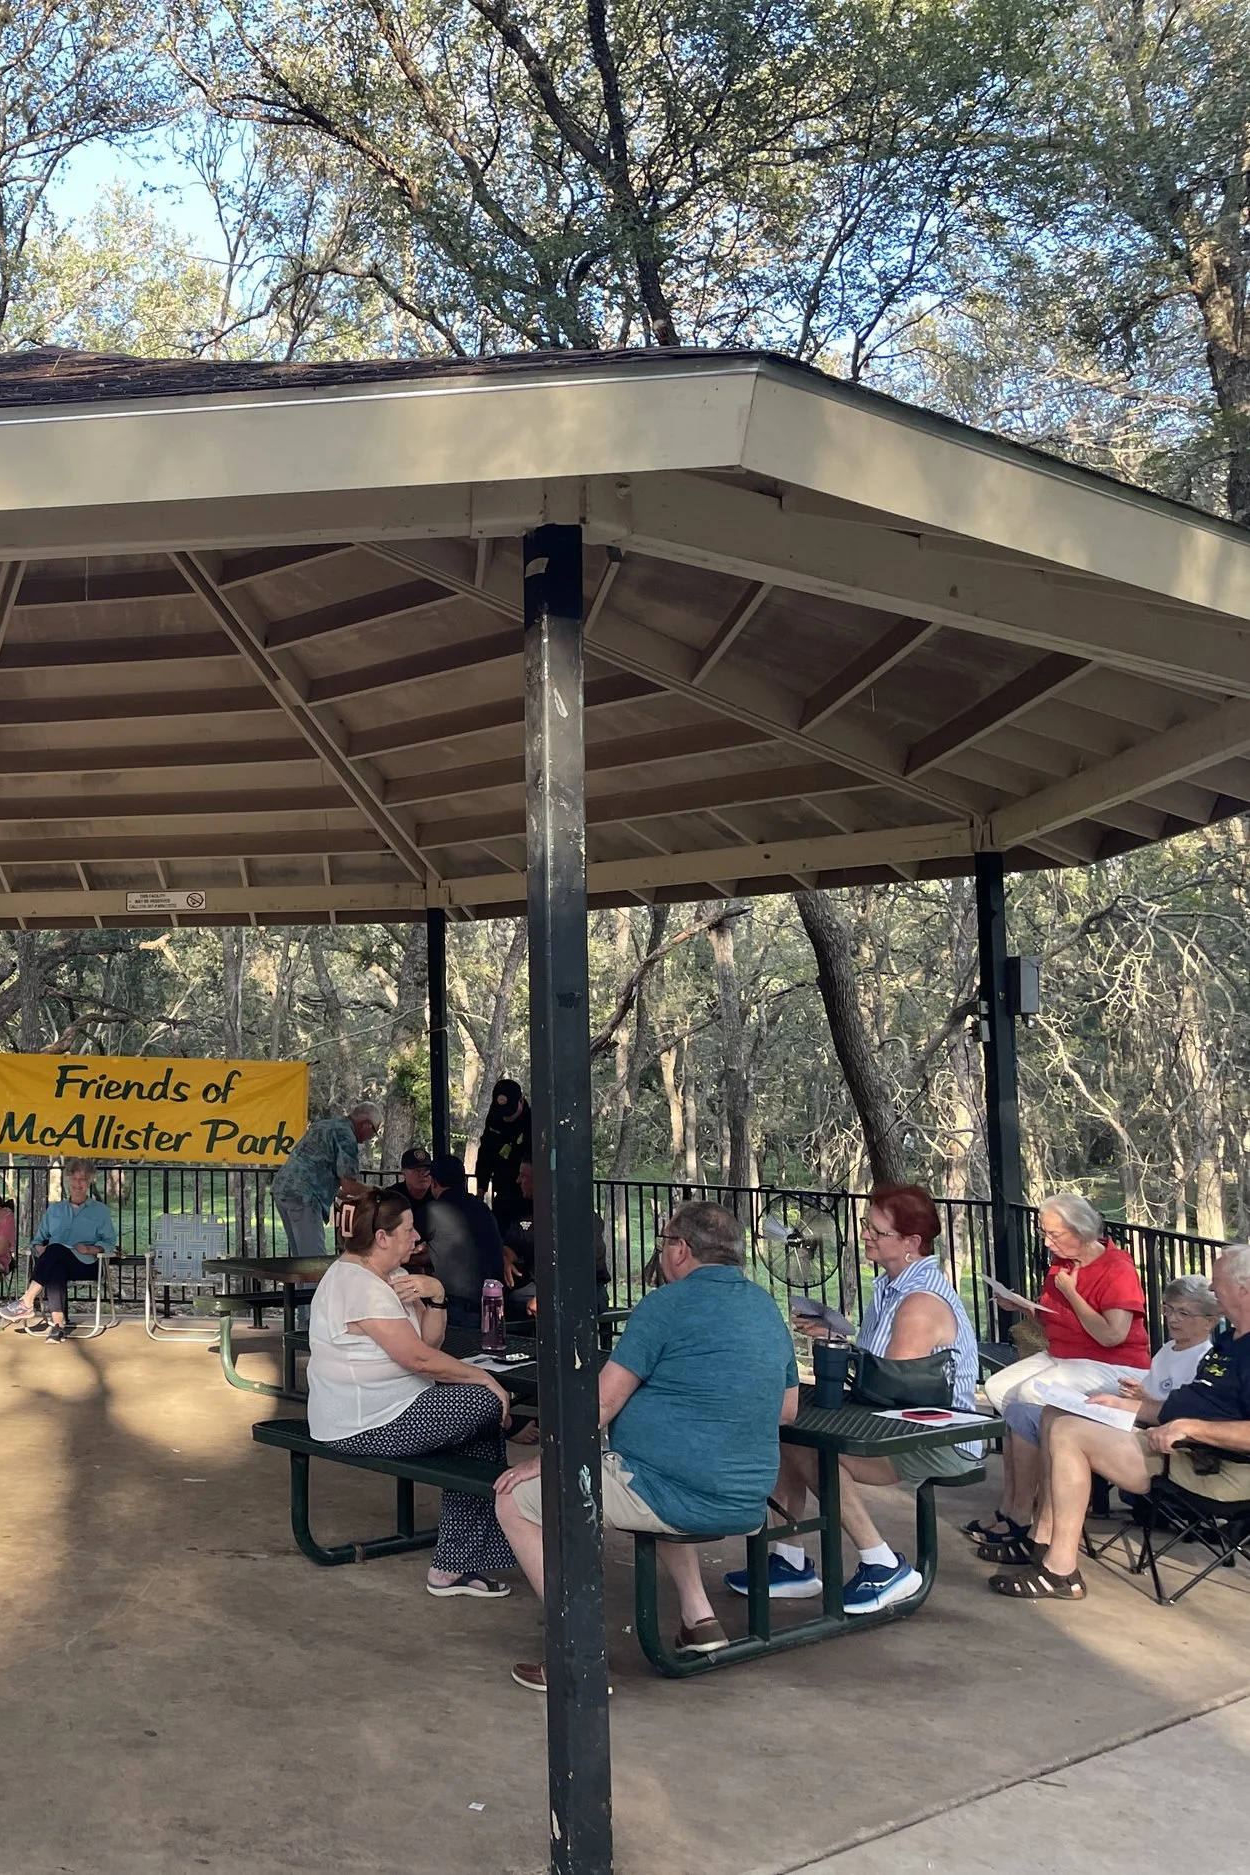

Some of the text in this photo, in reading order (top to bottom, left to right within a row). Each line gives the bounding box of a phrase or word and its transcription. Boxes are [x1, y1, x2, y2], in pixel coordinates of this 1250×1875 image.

[55, 1064, 242, 1104] Friends of
[200, 1119, 296, 1156] Park
